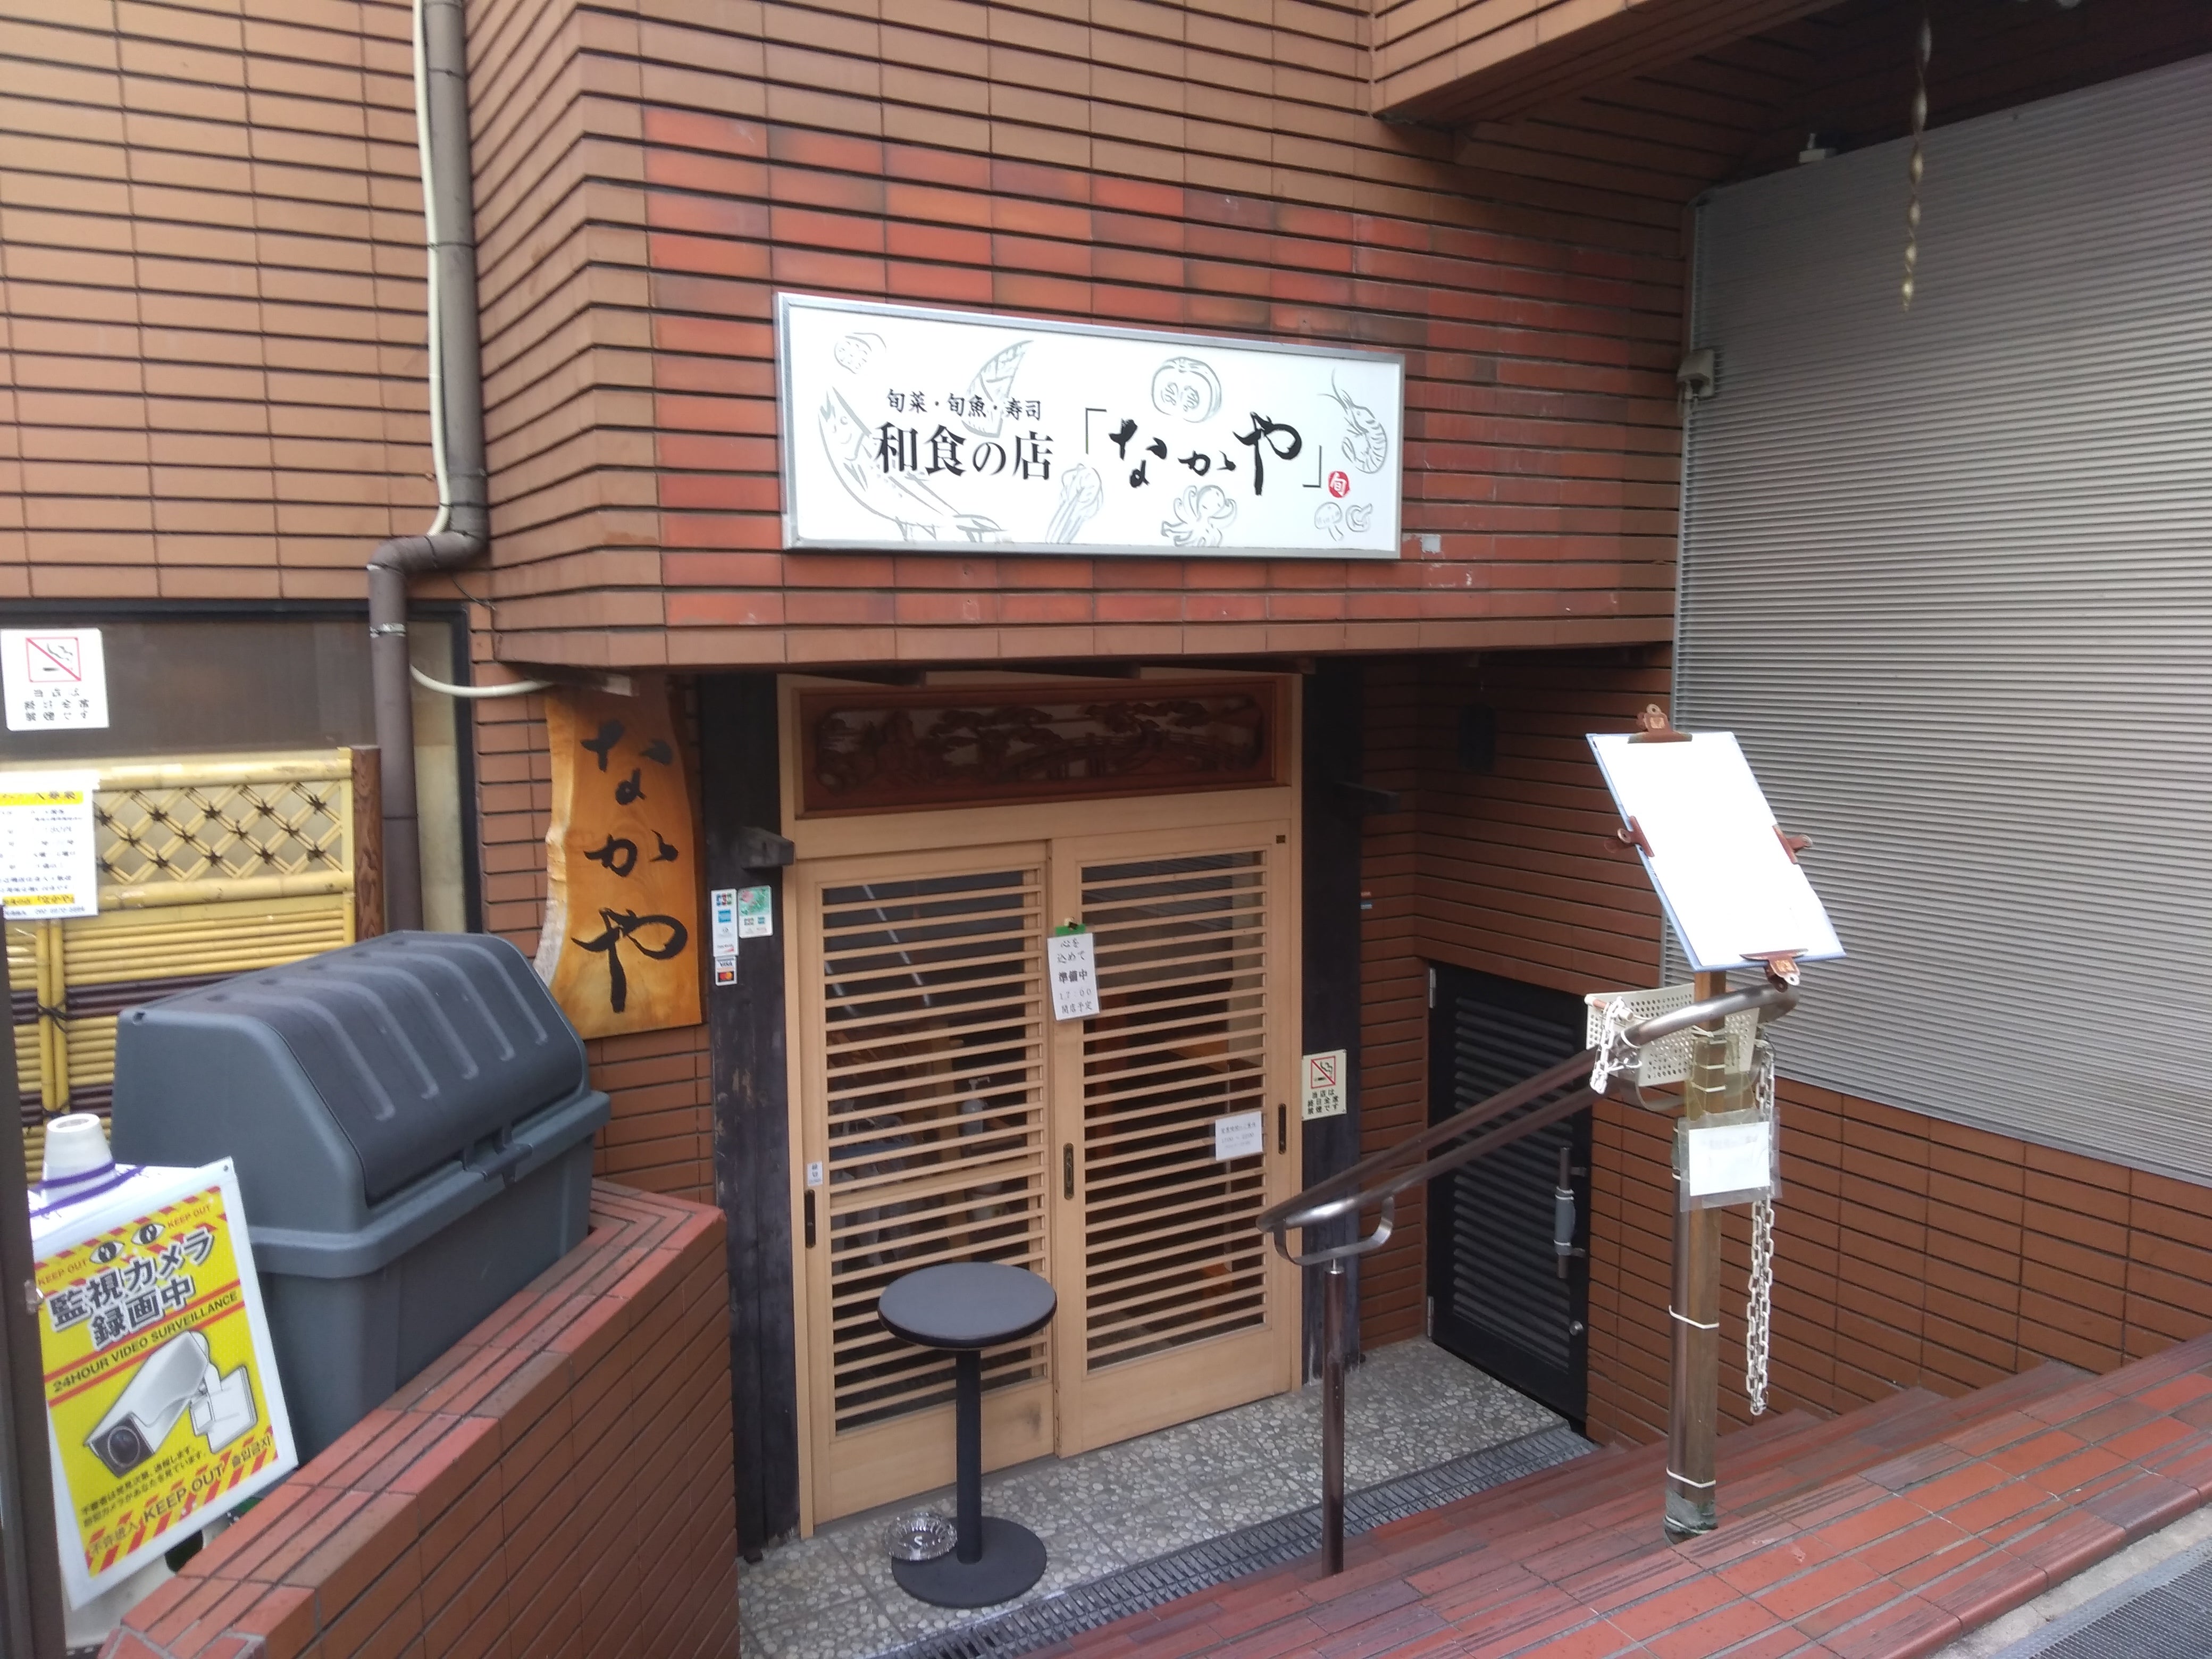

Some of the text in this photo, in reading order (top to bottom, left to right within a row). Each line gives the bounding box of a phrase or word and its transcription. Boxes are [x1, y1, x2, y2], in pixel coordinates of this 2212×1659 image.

[886, 388, 1043, 422] 旬菜・旬魚・寿司
[875, 423, 1054, 481] 和食の店
[1330, 474, 1347, 496] 旬
[571, 719, 688, 1012] なかや
[1060, 938, 1079, 948] 心を
[1057, 950, 1085, 964] 込めて
[1058, 968, 1088, 983] 準備中
[1061, 1001, 1093, 1014] 開店予定
[1312, 1088, 1335, 1099] 当店は
[1308, 1103, 1338, 1115] 禁煙です
[167, 1204, 211, 1229] KEEP OUT
[38, 1260, 88, 1286] KEEP OUT
[50, 1229, 214, 1329] 監視カメラ
[91, 1278, 195, 1348] 録画中
[53, 1291, 238, 1393] 24HOUR VIDEO SURVEILLANCE
[144, 1487, 187, 1522] KEEP
[191, 1462, 223, 1492] OUT
